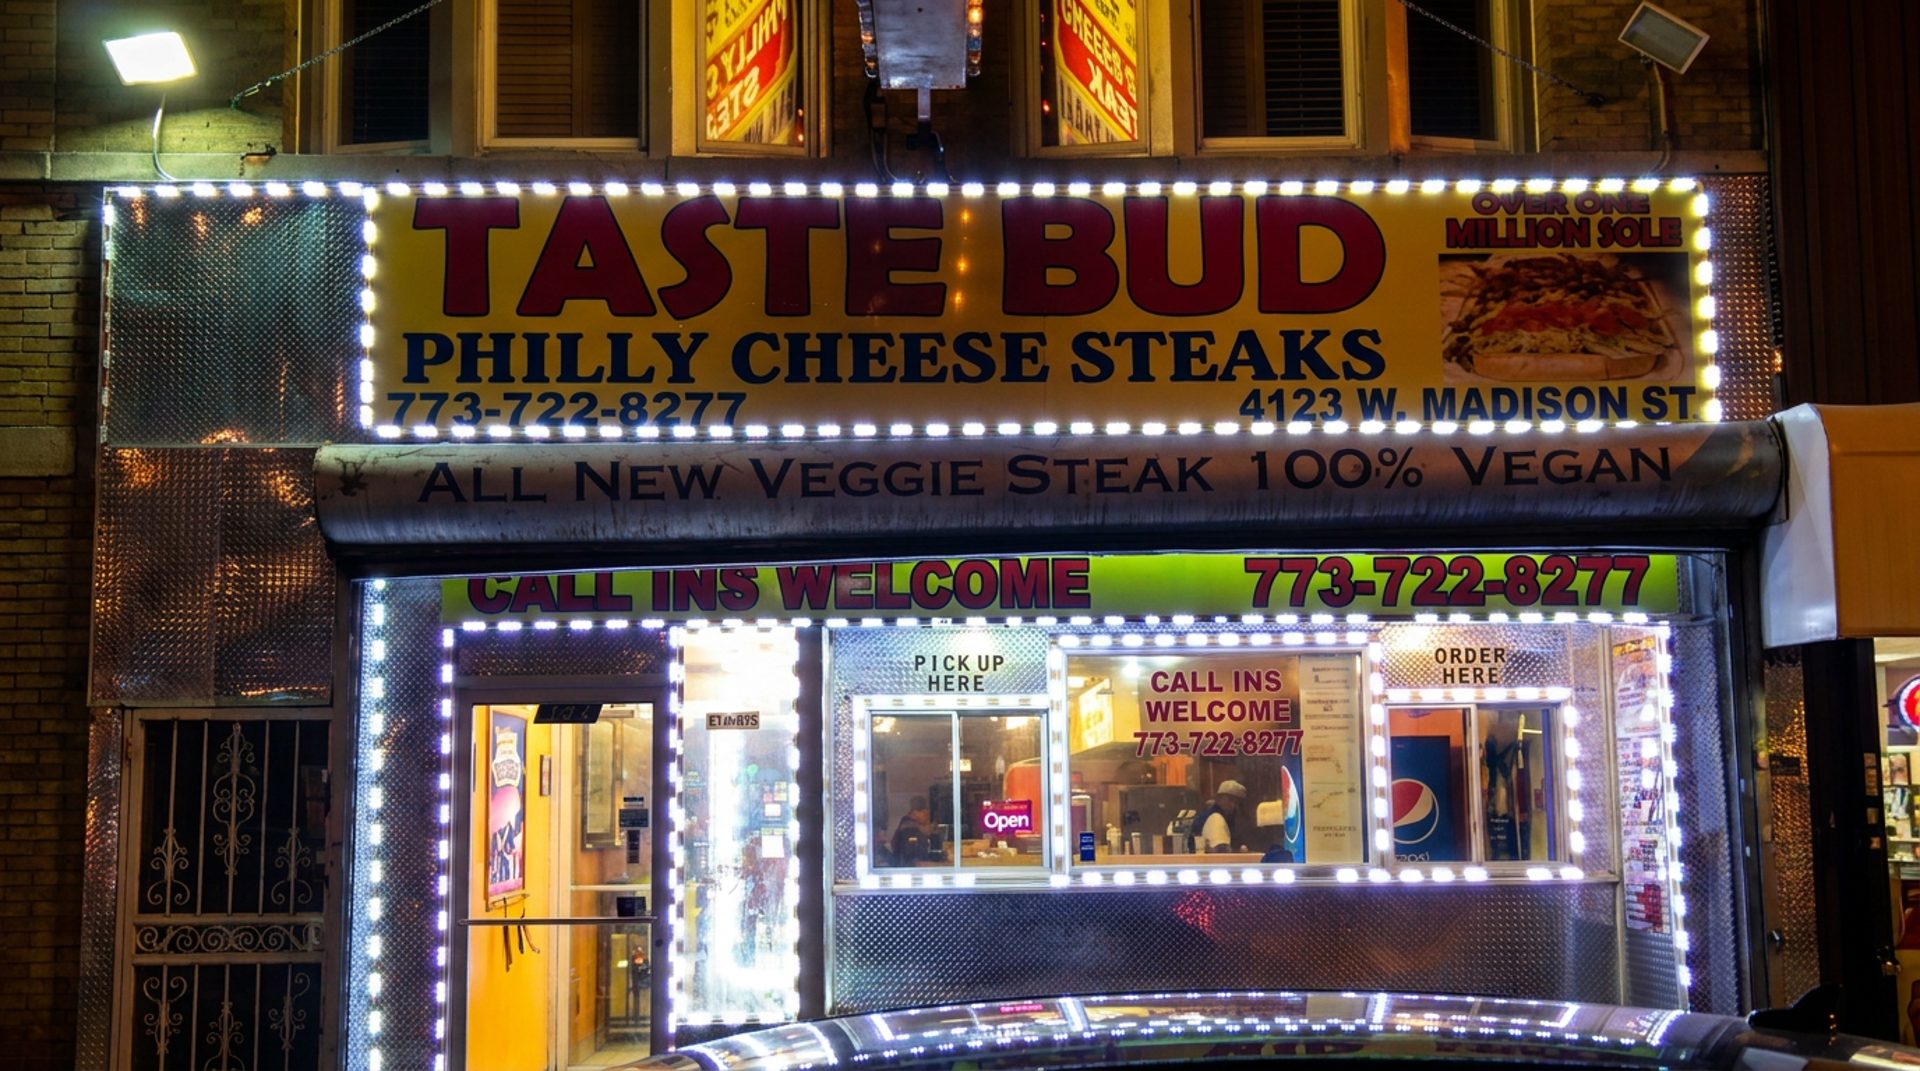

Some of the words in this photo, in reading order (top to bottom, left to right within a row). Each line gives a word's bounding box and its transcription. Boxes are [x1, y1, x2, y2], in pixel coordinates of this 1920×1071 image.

[1471, 191, 1570, 216] OVER
[1574, 190, 1650, 215] ONE
[1446, 217, 1592, 249] MILLION
[412, 195, 947, 320] TASTE
[1002, 196, 1386, 317] BUD
[402, 332, 709, 384] PHILLY
[731, 331, 1050, 385] CHEESE
[1071, 328, 1386, 383] STEAKS
[387, 392, 747, 427] 773-722-8277
[1239, 388, 1343, 422] 4123
[1357, 388, 1407, 421] W.
[1422, 386, 1635, 421] MADISON
[418, 462, 547, 503] ALL
[574, 461, 725, 500] NEW
[748, 458, 985, 499] VEGGIE
[1007, 454, 1214, 494] STEAK
[1251, 446, 1424, 490] 100%
[1451, 446, 1672, 486] VEGAN
[468, 572, 633, 614] CALL
[651, 567, 760, 612] INS
[777, 557, 1092, 612] WELCOME
[1244, 555, 1650, 609] 773-722-8277
[914, 654, 971, 672] PICK
[977, 654, 1005, 671] UP
[1435, 647, 1506, 664] ORDER
[928, 675, 985, 692] HERE
[1150, 670, 1224, 694] CALL
[1232, 669, 1283, 693] INS
[1443, 667, 1499, 684] HERE
[1145, 699, 1292, 723] WELCOME
[984, 811, 1030, 832] Open
